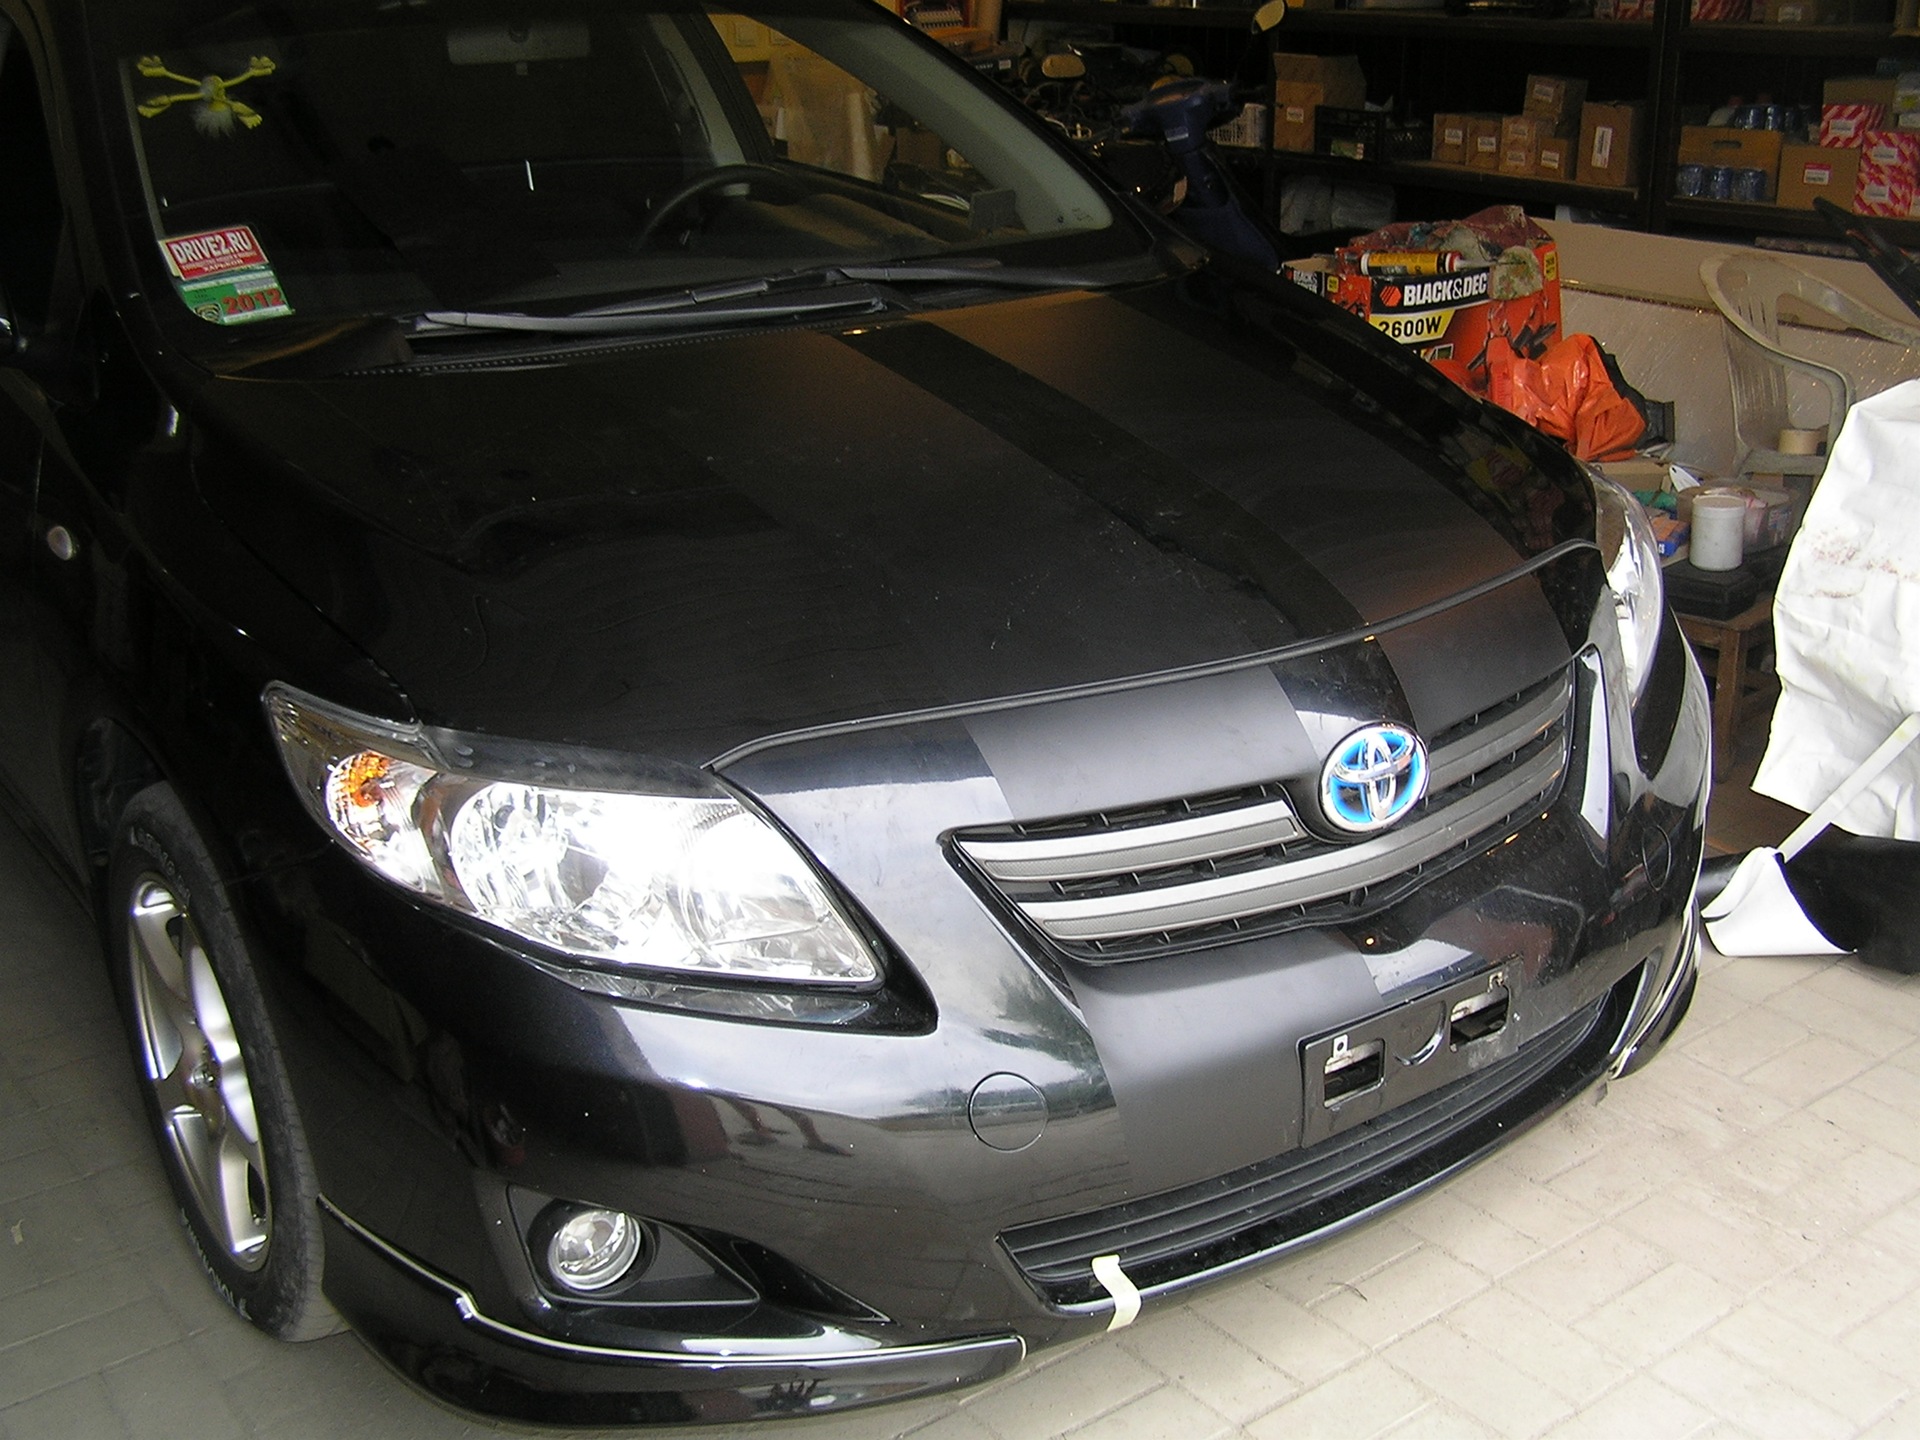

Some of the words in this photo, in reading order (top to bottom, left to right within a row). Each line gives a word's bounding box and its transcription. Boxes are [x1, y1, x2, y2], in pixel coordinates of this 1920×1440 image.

[171, 231, 252, 263] DRIVE2.RU
[223, 288, 285, 314] 2012
[1379, 315, 1442, 339] 2600W
